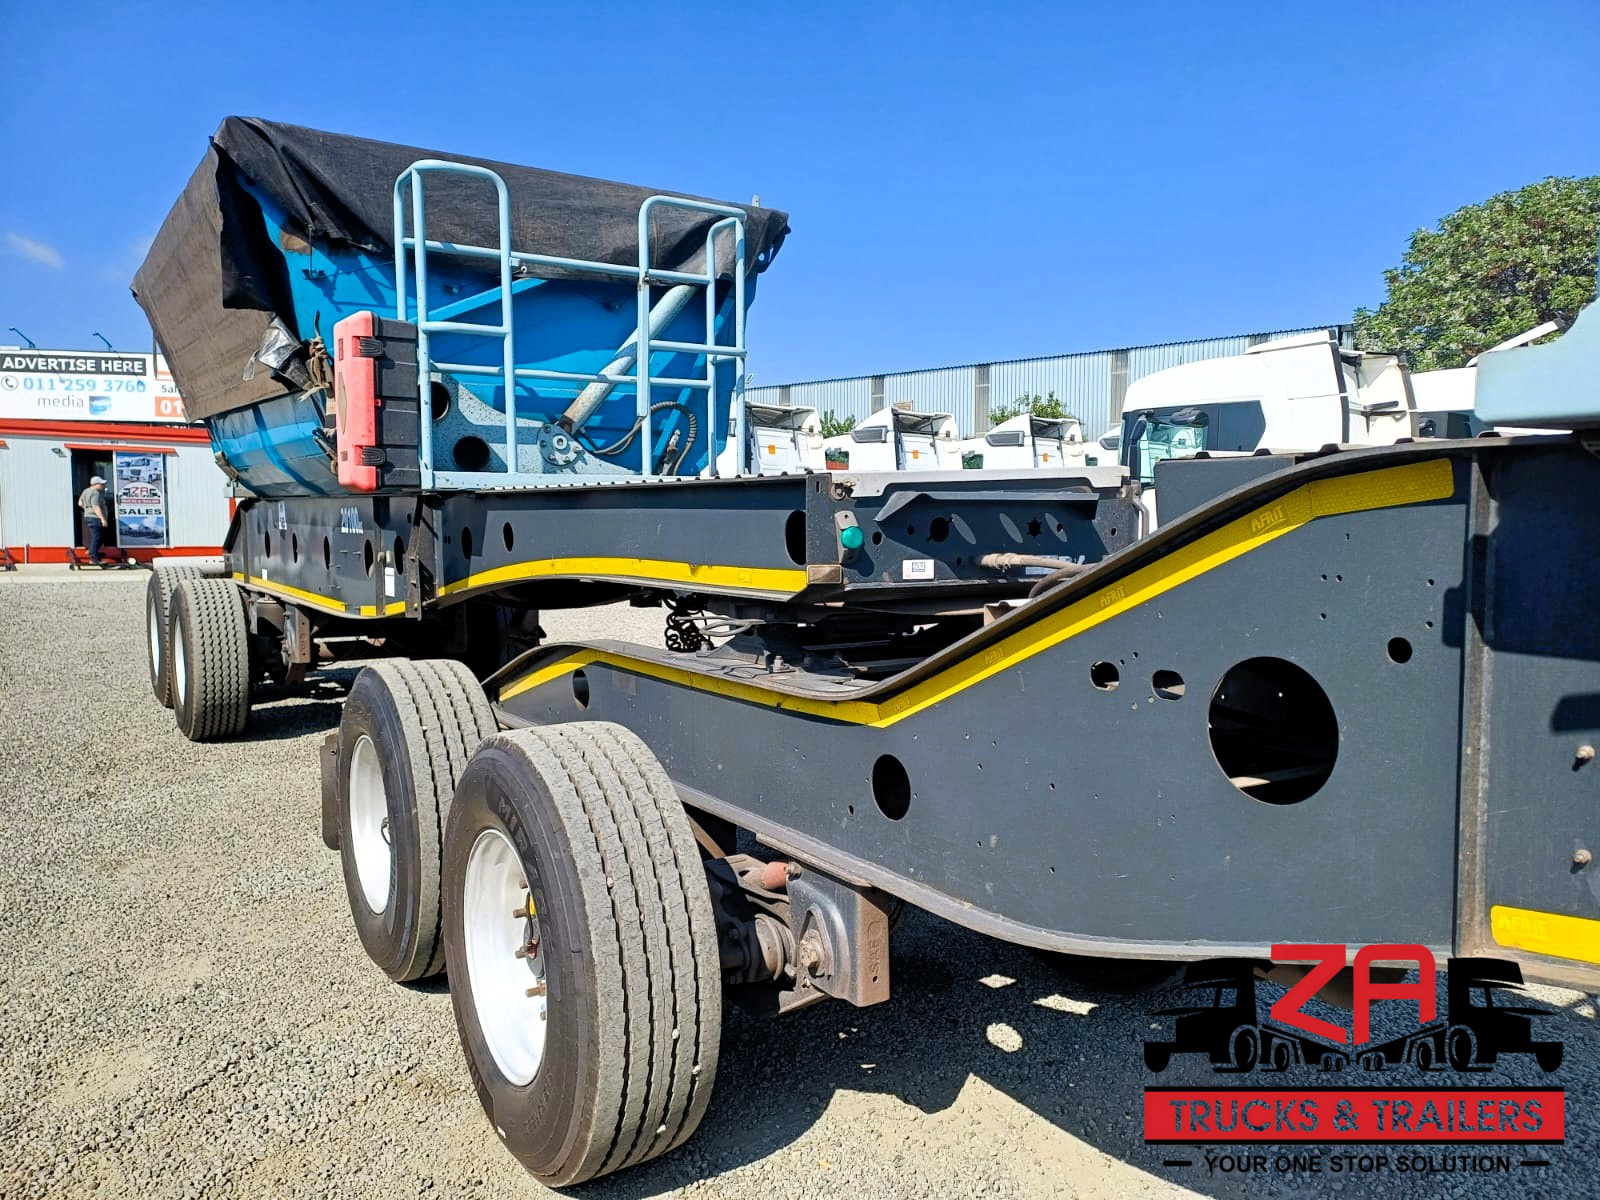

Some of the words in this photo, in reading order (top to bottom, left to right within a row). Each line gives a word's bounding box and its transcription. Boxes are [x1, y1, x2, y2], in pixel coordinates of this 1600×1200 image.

[2, 357, 96, 371] ADVERTISE
[101, 359, 143, 373] HERE
[23, 377, 56, 391] 011
[64, 378, 97, 391] 259
[37, 395, 84, 407] media
